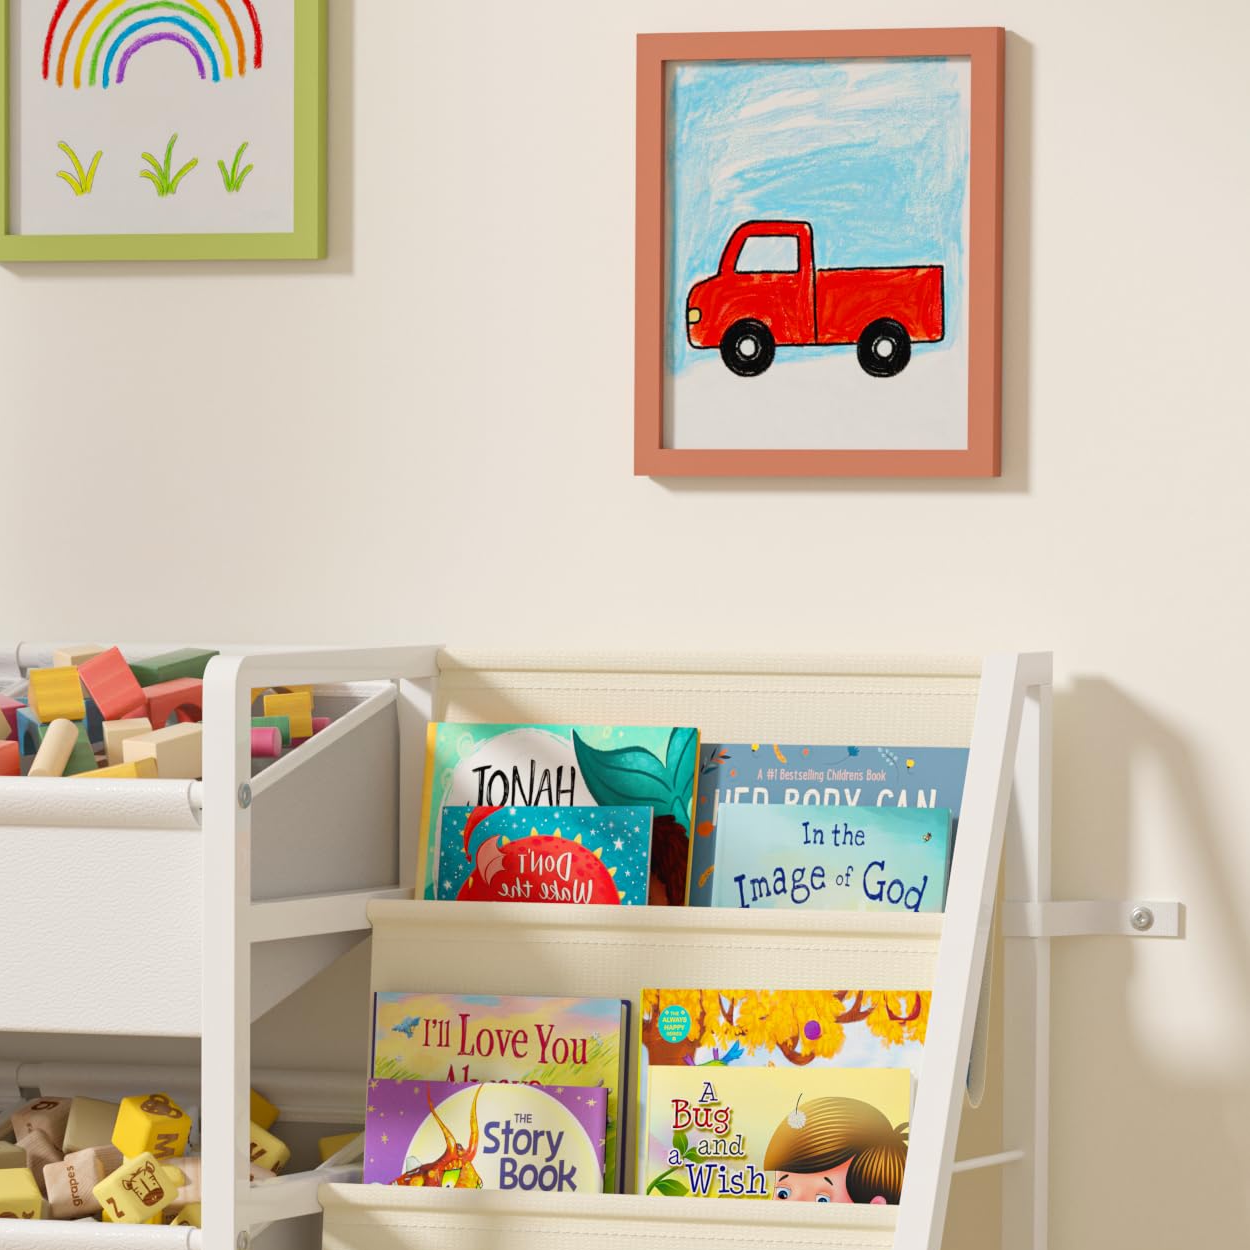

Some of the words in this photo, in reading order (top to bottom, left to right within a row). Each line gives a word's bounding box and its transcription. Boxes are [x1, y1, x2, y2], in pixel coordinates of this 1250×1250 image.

[467, 760, 576, 807] JONAH
[757, 768, 763, 780] A
[767, 768, 778, 780] #1
[779, 768, 824, 782] Bestselling
[866, 768, 887, 781] Book
[802, 821, 825, 845] In
[831, 822, 865, 847] the
[734, 865, 826, 908] Image
[835, 865, 854, 887] of
[862, 860, 929, 912] God
[422, 1018, 451, 1048] I'll
[457, 1013, 529, 1059] Love
[534, 1024, 589, 1065] You
[698, 1081, 719, 1103] A
[513, 1113, 533, 1124] THE
[671, 1098, 731, 1134] Bug
[482, 1120, 565, 1162] Story
[668, 1149, 682, 1165] a
[697, 1134, 744, 1156] and
[66, 1165, 84, 1207] grapes
[499, 1157, 578, 1193] Book
[685, 1163, 767, 1195] Wish
